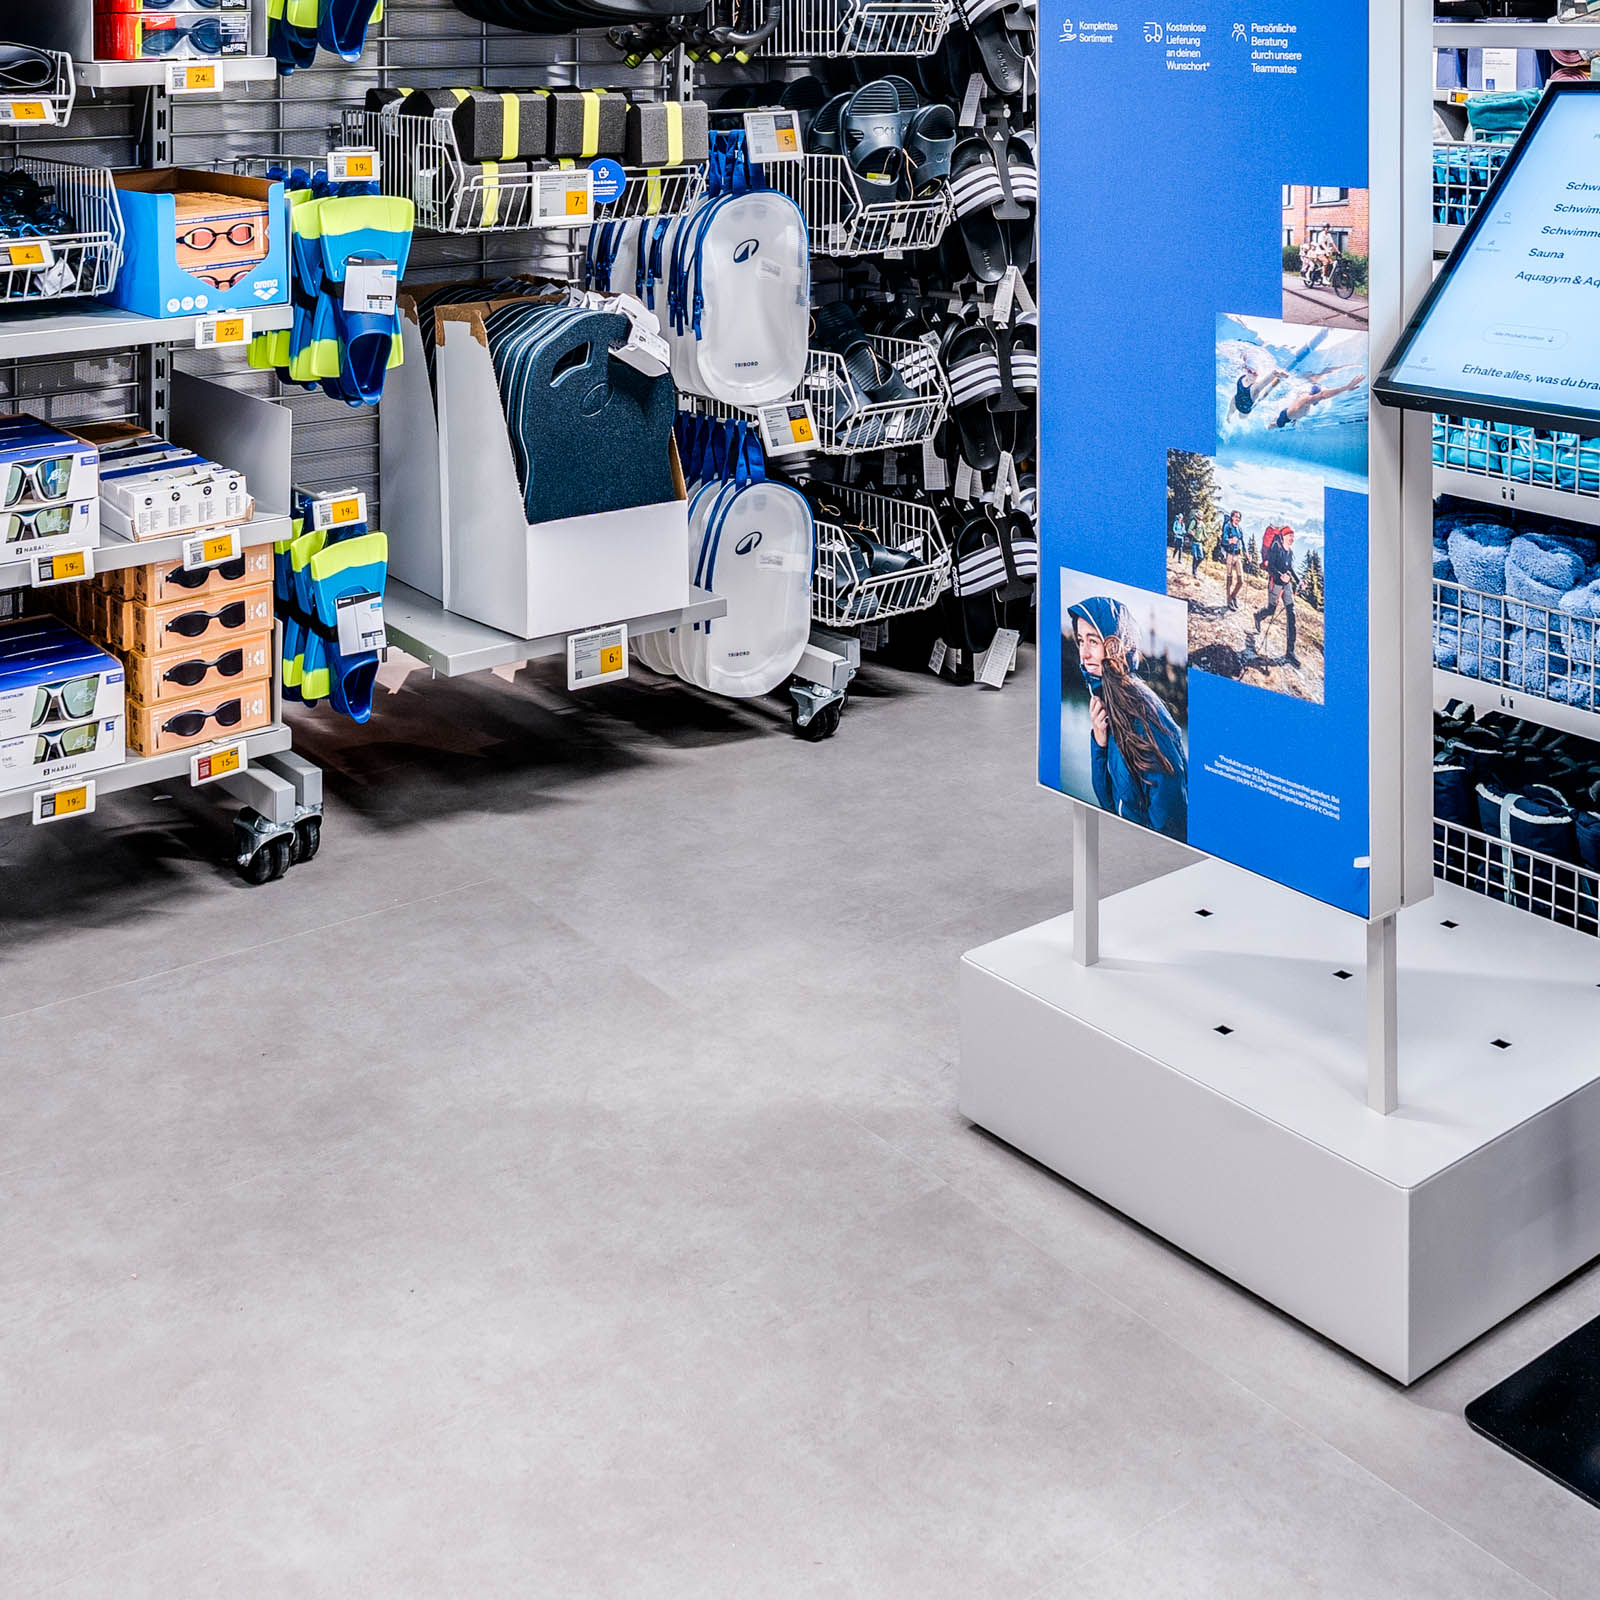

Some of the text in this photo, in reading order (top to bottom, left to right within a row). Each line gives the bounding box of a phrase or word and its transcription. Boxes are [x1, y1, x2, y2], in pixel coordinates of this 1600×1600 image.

[1079, 21, 1118, 32] Komplettes
[1166, 22, 1206, 32] Kostenlose
[1251, 22, 1297, 33] Persönliche
[1079, 34, 1113, 43] Sortiment
[1166, 35, 1200, 47] Lieferung
[1251, 37, 1288, 48] Beratung
[1166, 49, 1201, 58] an deinen
[1251, 50, 1302, 60] durch unsere
[1251, 63, 1297, 74] Teammates
[1528, 248, 1565, 259] Sauna
[1515, 271, 1572, 285] Aquagym
[1572, 275, 1582, 285] &
[1462, 363, 1503, 378] Erhalte
[1503, 369, 1533, 384] alles,
[1535, 375, 1560, 385] was
[1560, 377, 1577, 388] du
